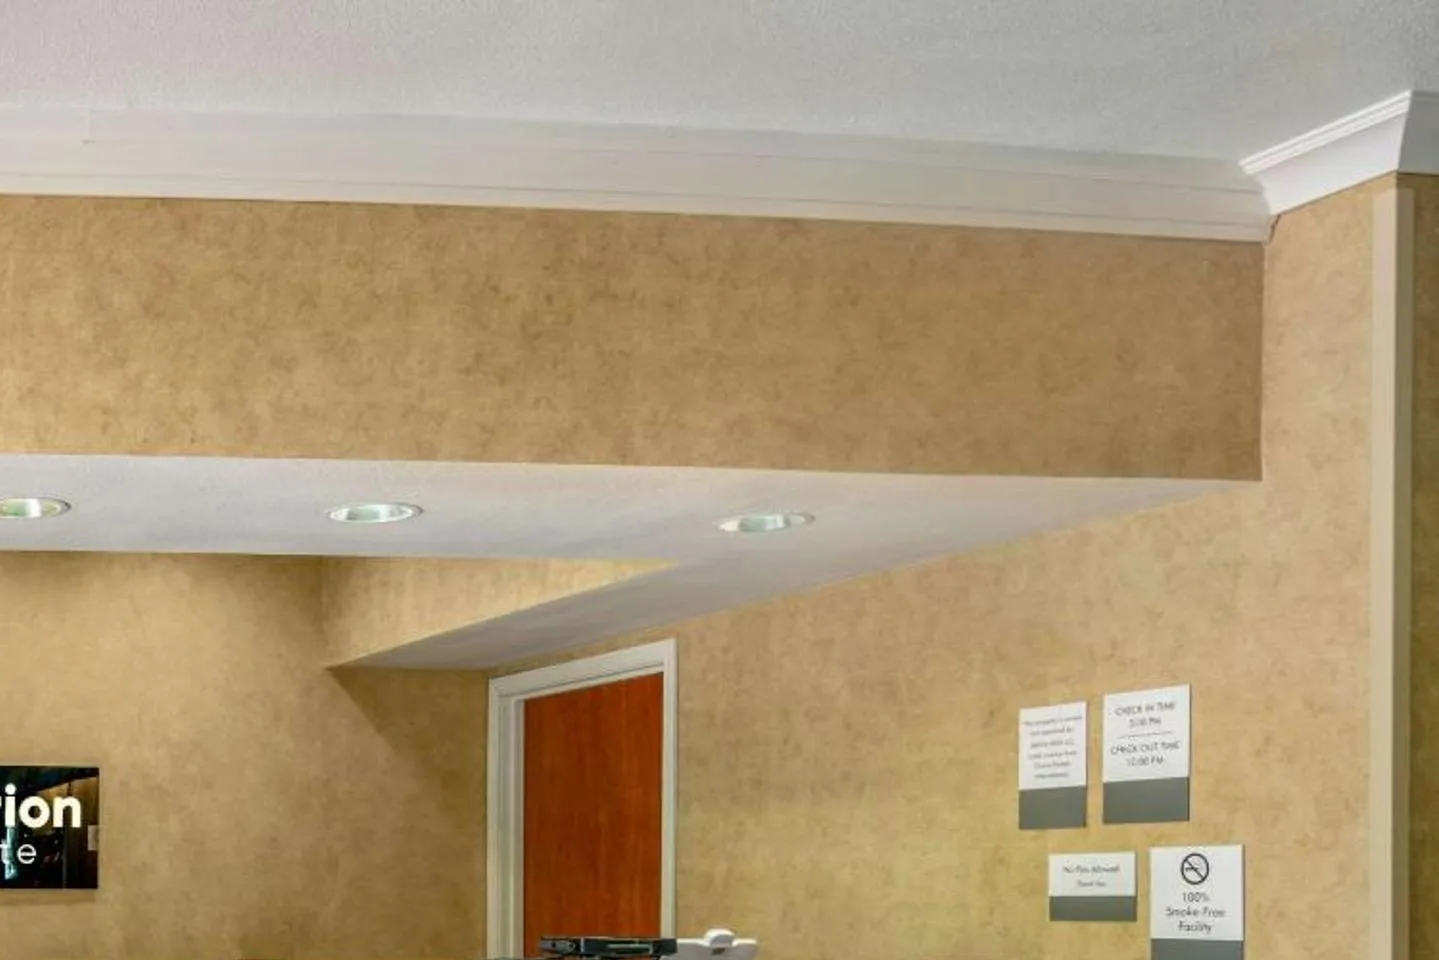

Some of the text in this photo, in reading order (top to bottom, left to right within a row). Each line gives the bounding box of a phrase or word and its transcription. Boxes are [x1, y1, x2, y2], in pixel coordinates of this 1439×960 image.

[1113, 704, 1142, 717] CHECK
[1110, 743, 1137, 755] CHECK
[1140, 742, 1158, 753] OUT
[1183, 891, 1210, 902] 100%
